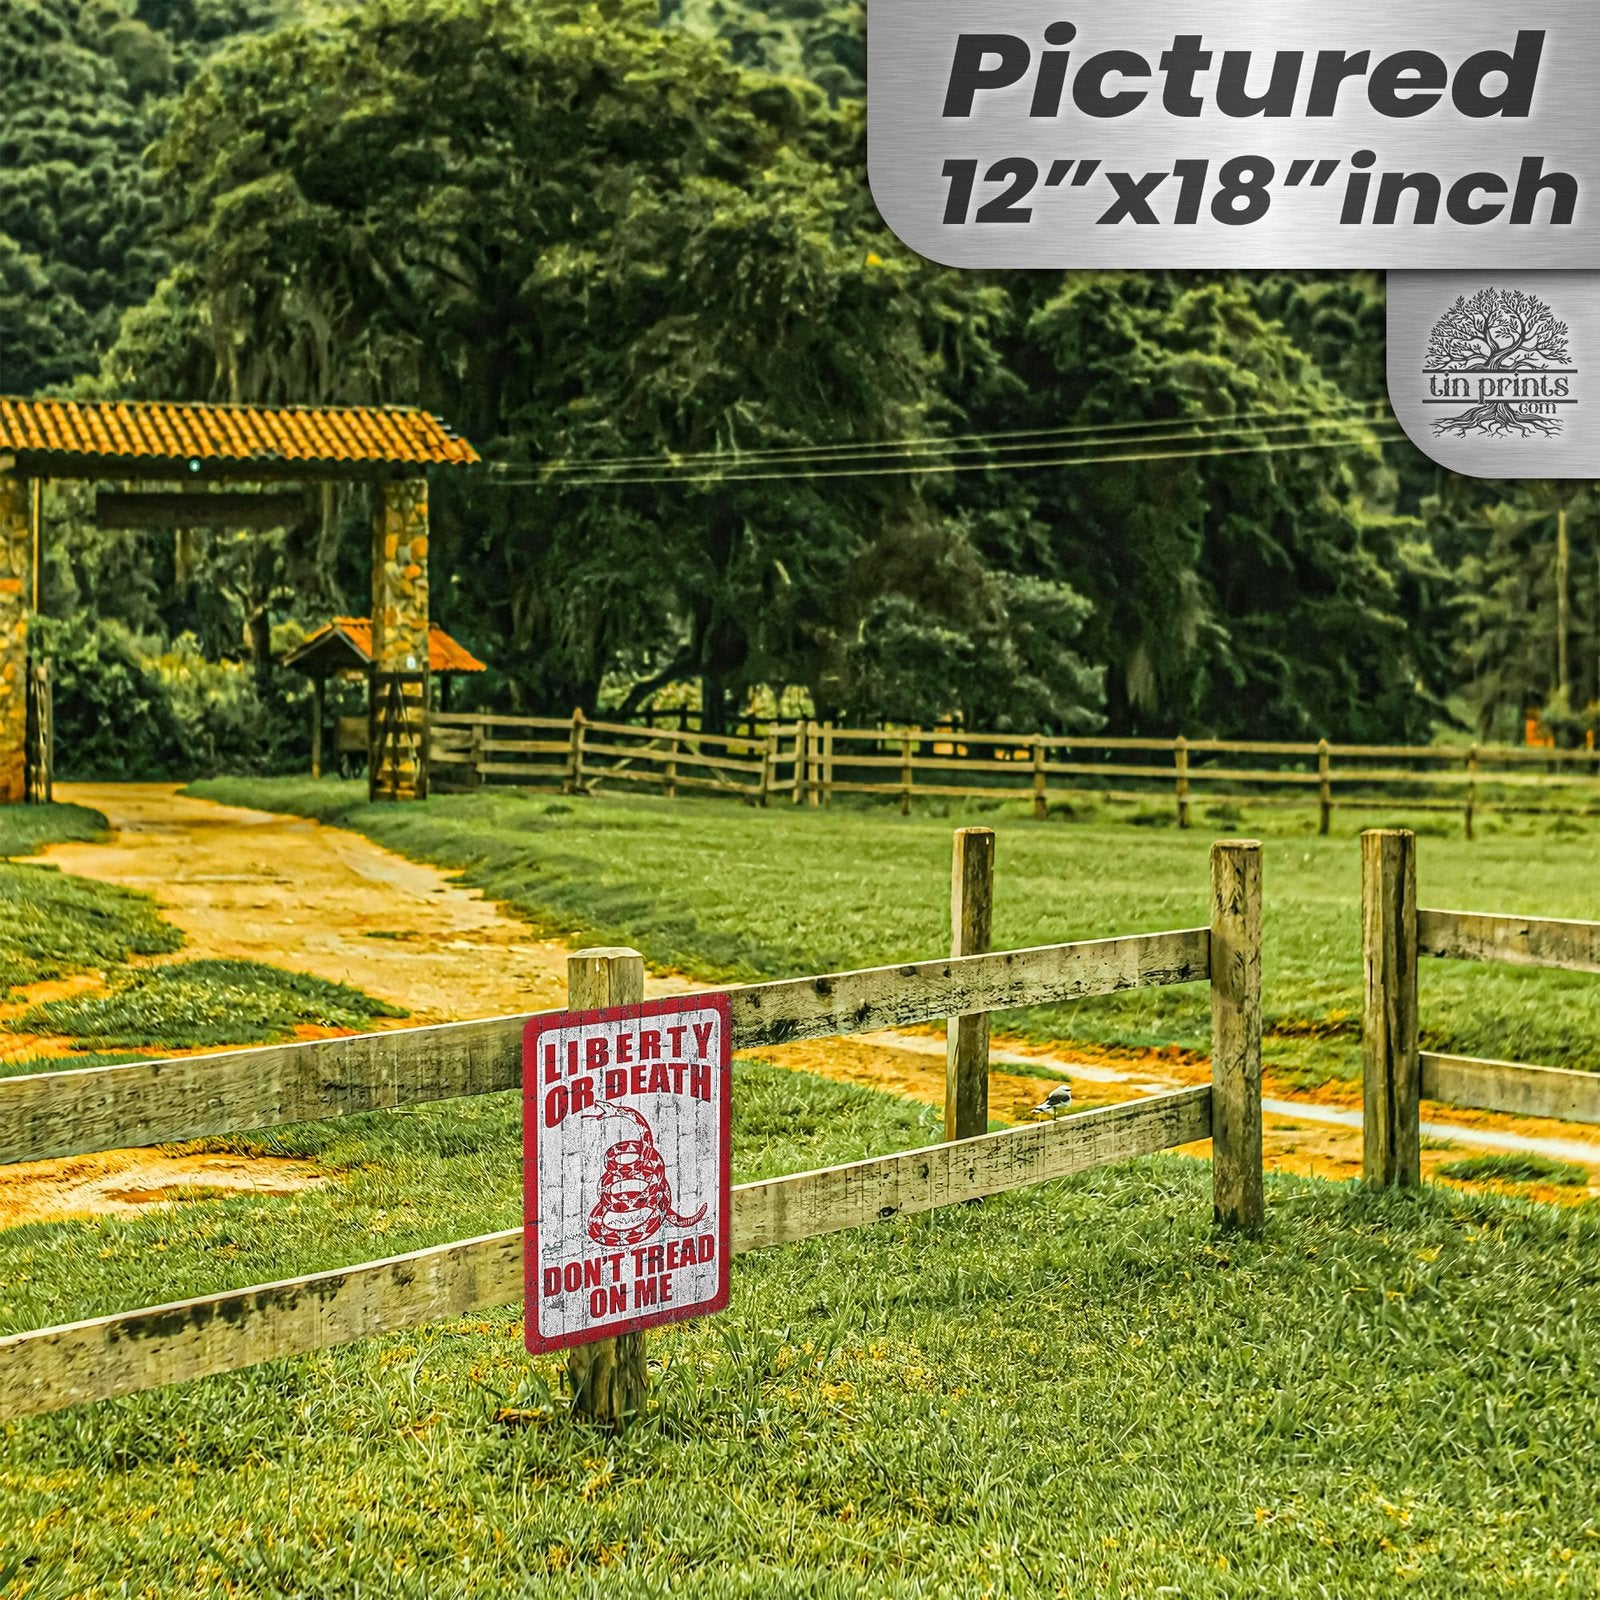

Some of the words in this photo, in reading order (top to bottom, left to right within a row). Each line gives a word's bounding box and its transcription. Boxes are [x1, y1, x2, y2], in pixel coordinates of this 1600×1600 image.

[544, 1021, 714, 1086] LIBERTY
[544, 1076, 595, 1129] OR
[605, 1062, 711, 1103] DEATH
[543, 1252, 622, 1298] DON'T
[631, 1234, 714, 1277] TREAD
[589, 1285, 633, 1319] ON
[635, 1272, 673, 1309] ME
